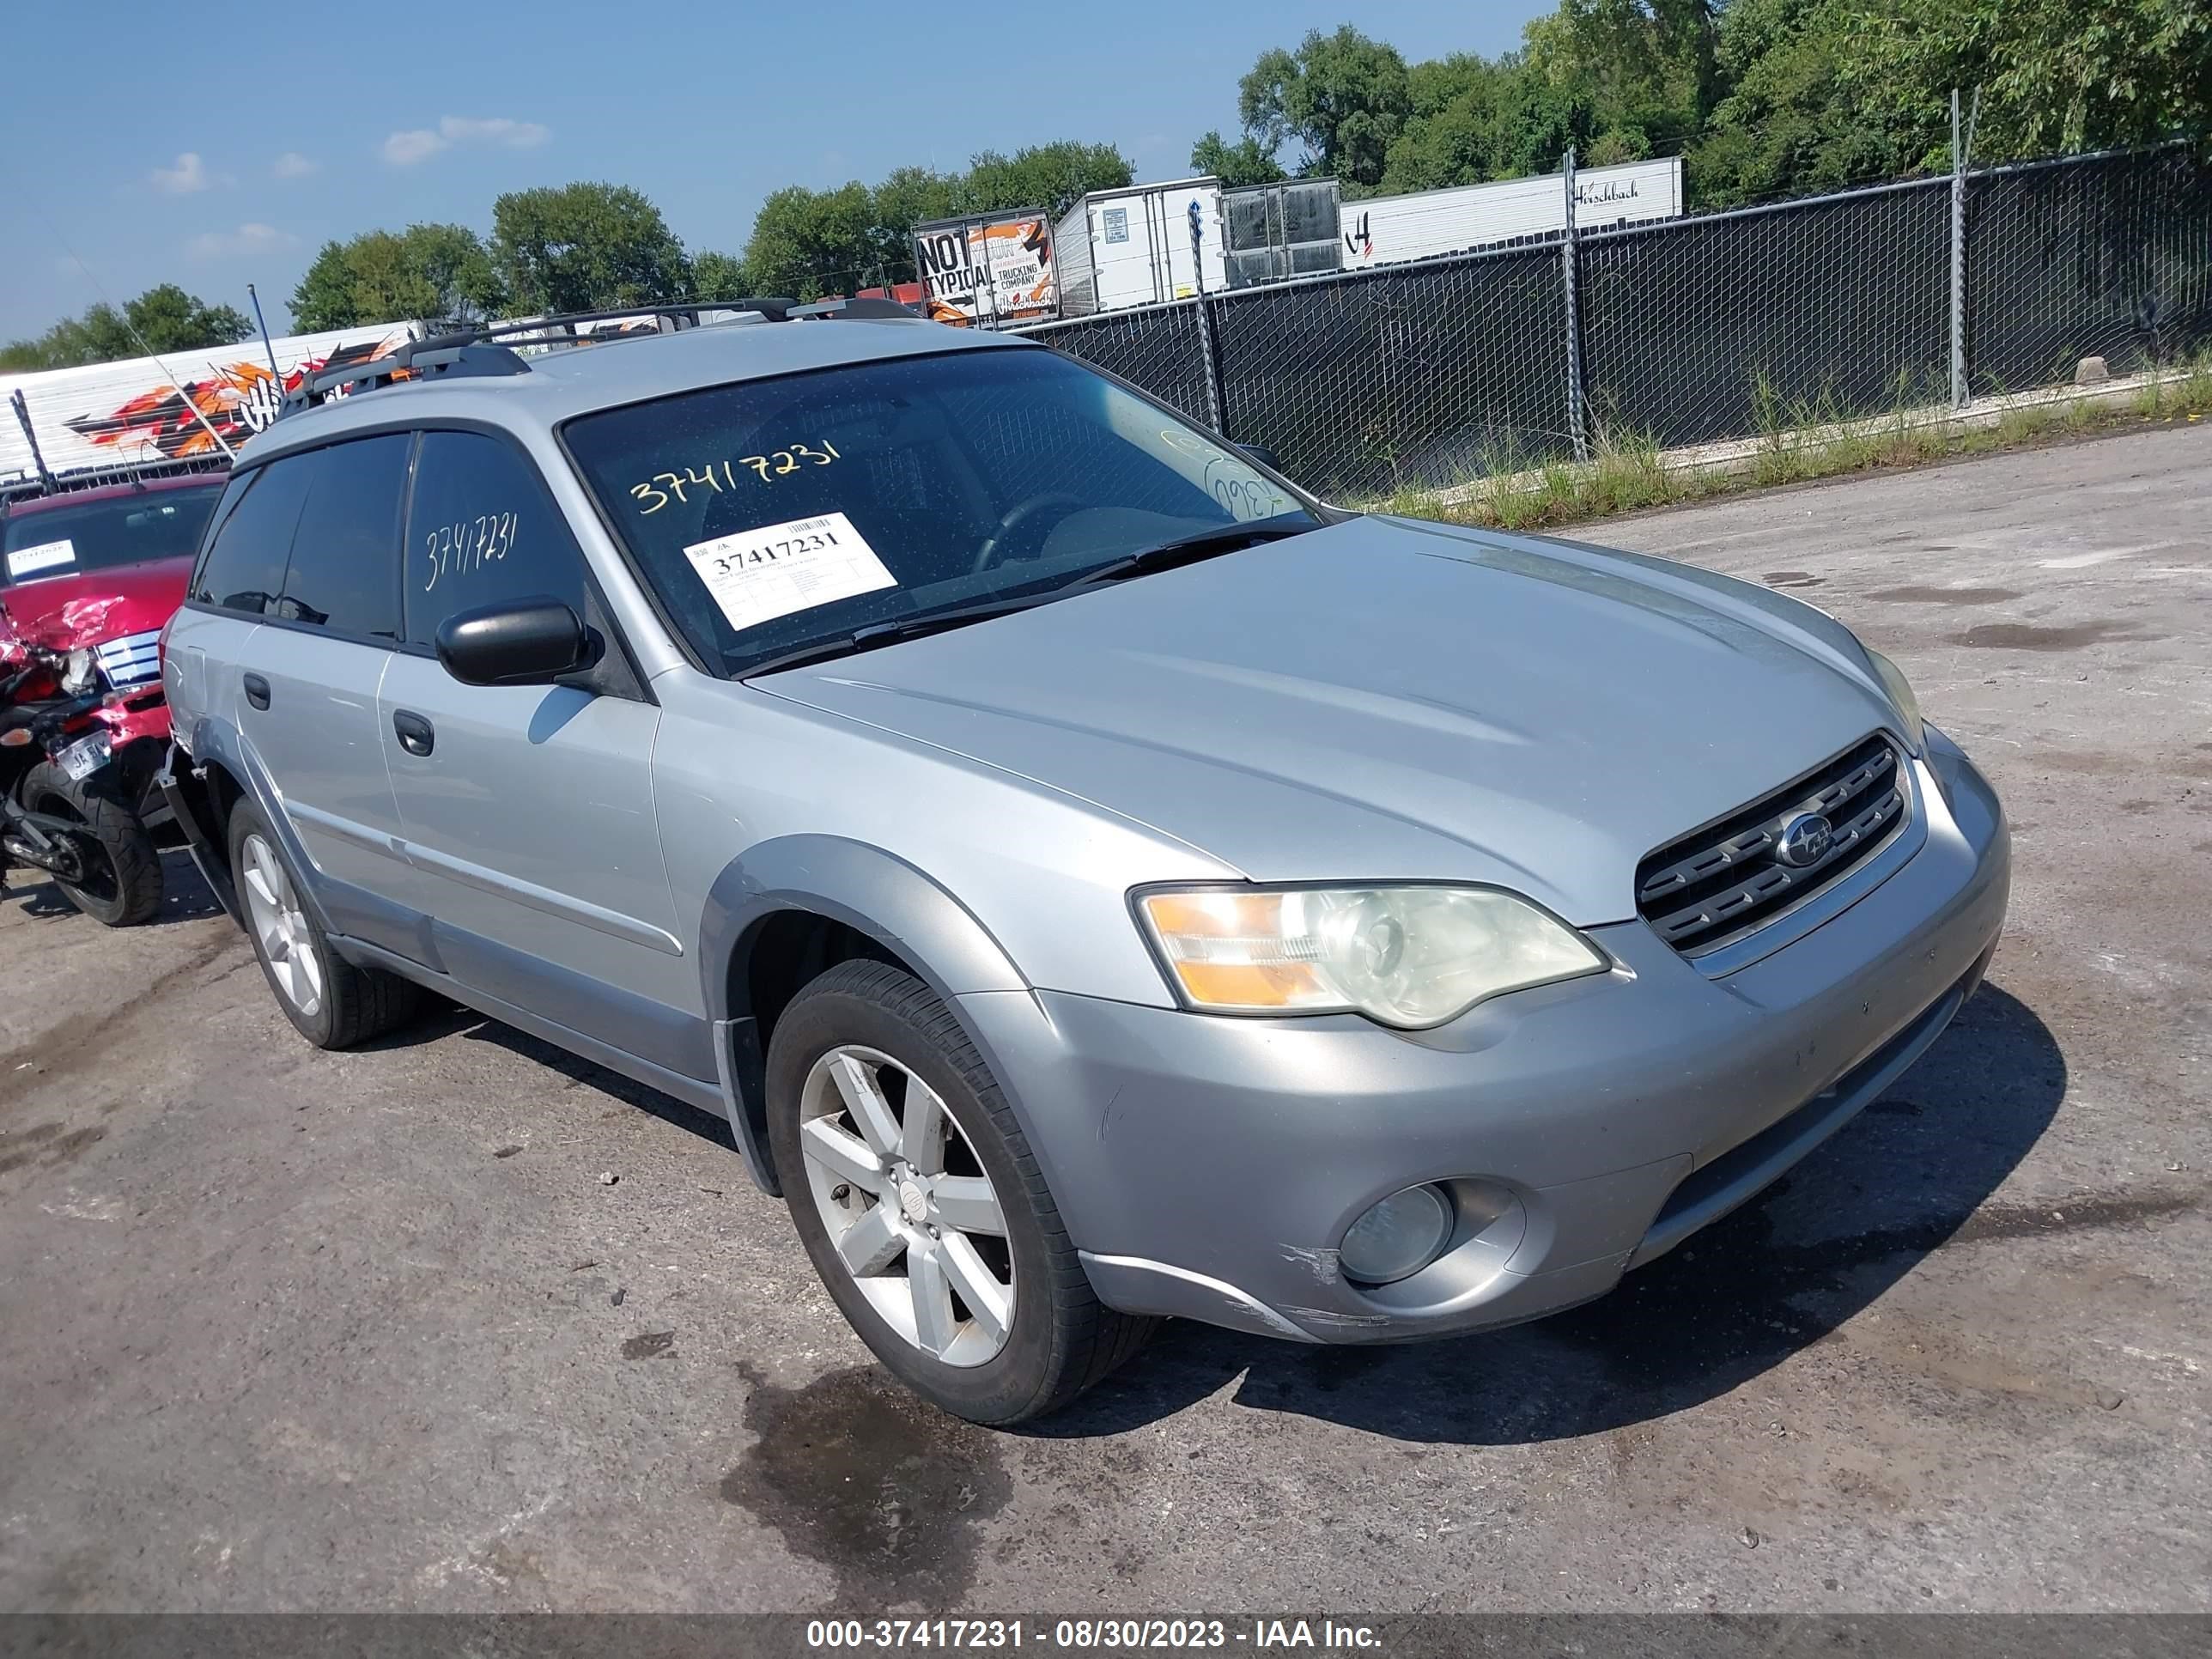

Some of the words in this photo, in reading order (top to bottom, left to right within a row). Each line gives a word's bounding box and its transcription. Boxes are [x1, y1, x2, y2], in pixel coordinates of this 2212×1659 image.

[1574, 179, 1638, 206] Hirschbach
[920, 232, 970, 276] NOT
[970, 239, 1015, 264] YOUR
[926, 264, 997, 297] TYPICAL
[998, 263, 1038, 281] TRUCKING
[1001, 275, 1038, 290] COMPANY.
[997, 292, 1054, 315] Hirschbach
[630, 439, 841, 514] 37417231
[425, 512, 517, 592] 37417231
[712, 532, 841, 575] 37417231
